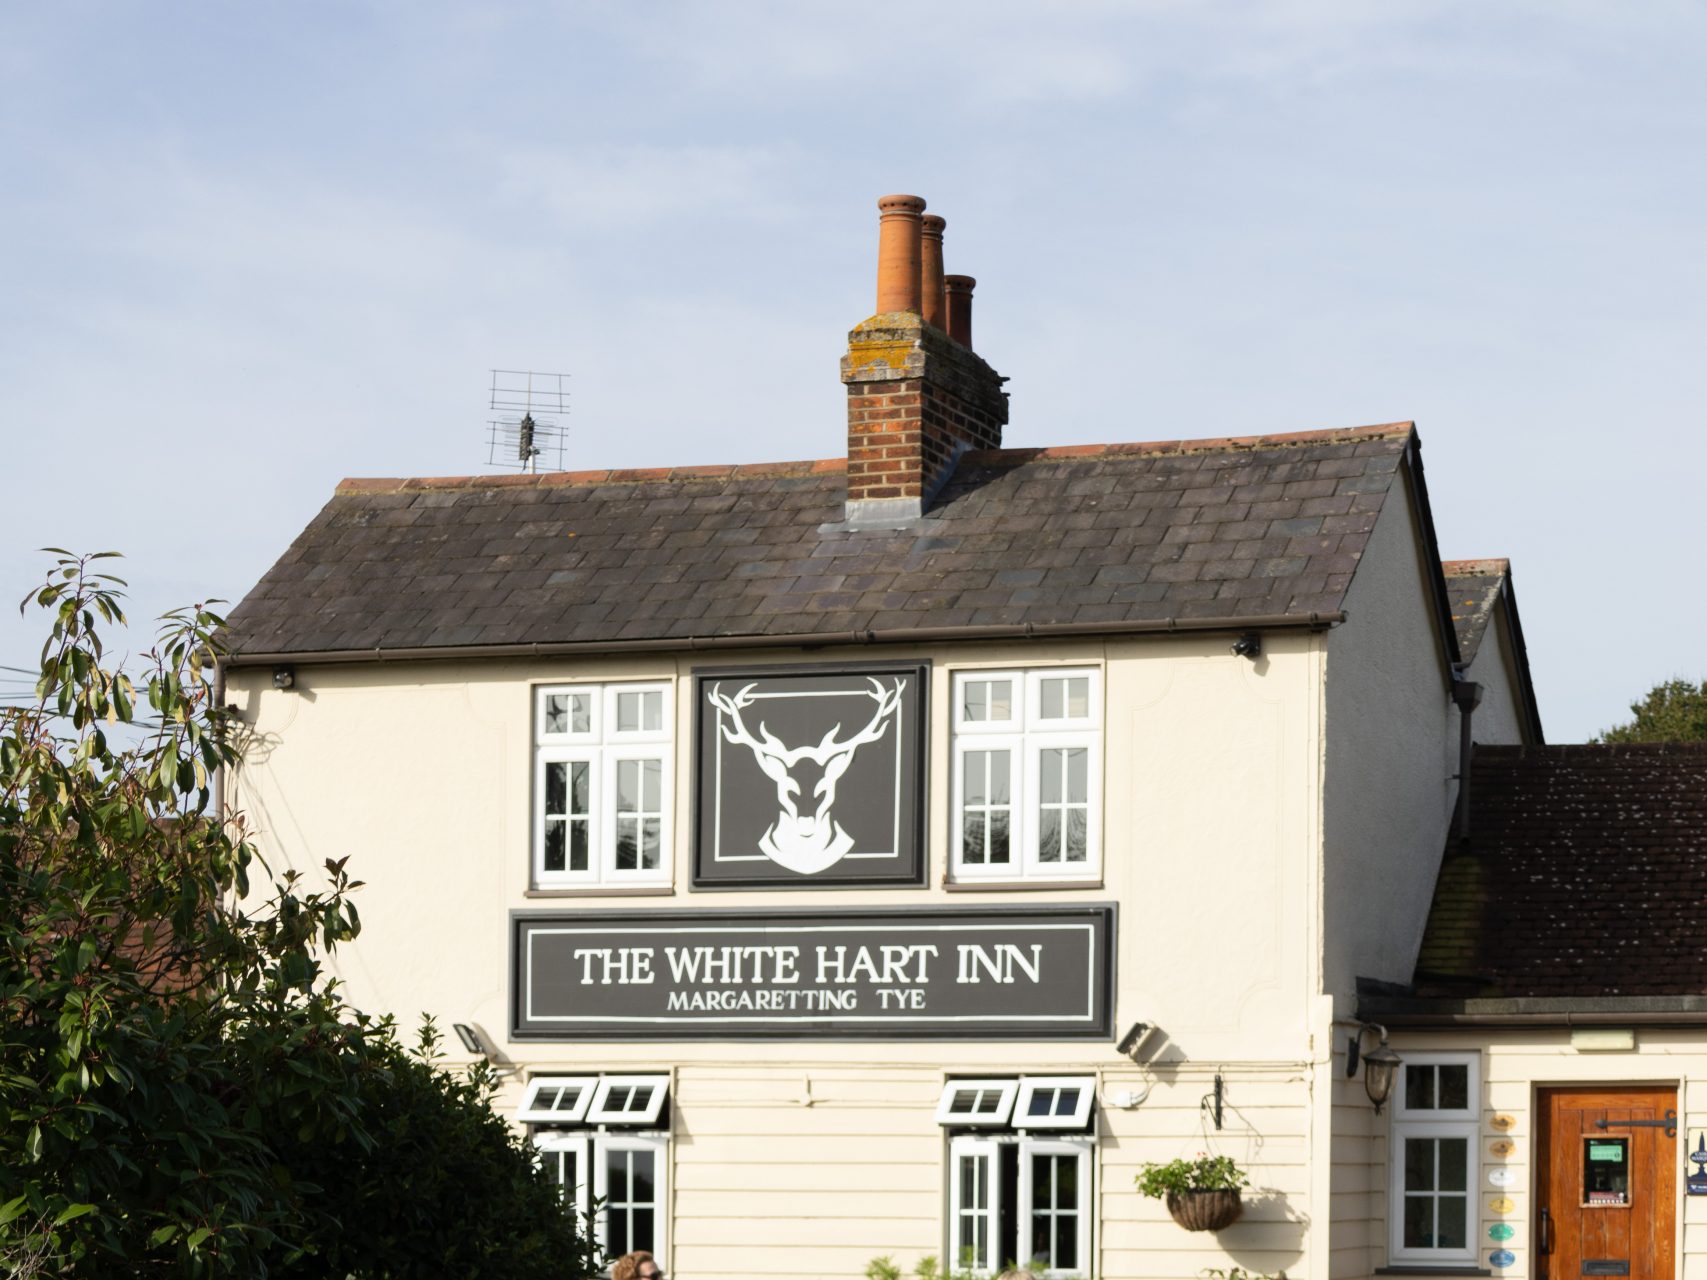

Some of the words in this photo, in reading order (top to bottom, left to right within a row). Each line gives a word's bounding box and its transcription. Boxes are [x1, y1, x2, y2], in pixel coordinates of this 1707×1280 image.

[573, 947, 656, 985] THE
[663, 946, 800, 984] WHITE
[814, 944, 939, 984] HART
[956, 943, 1043, 984] INN
[666, 989, 858, 1011] MARGARETTING
[875, 988, 926, 1010] TYE
